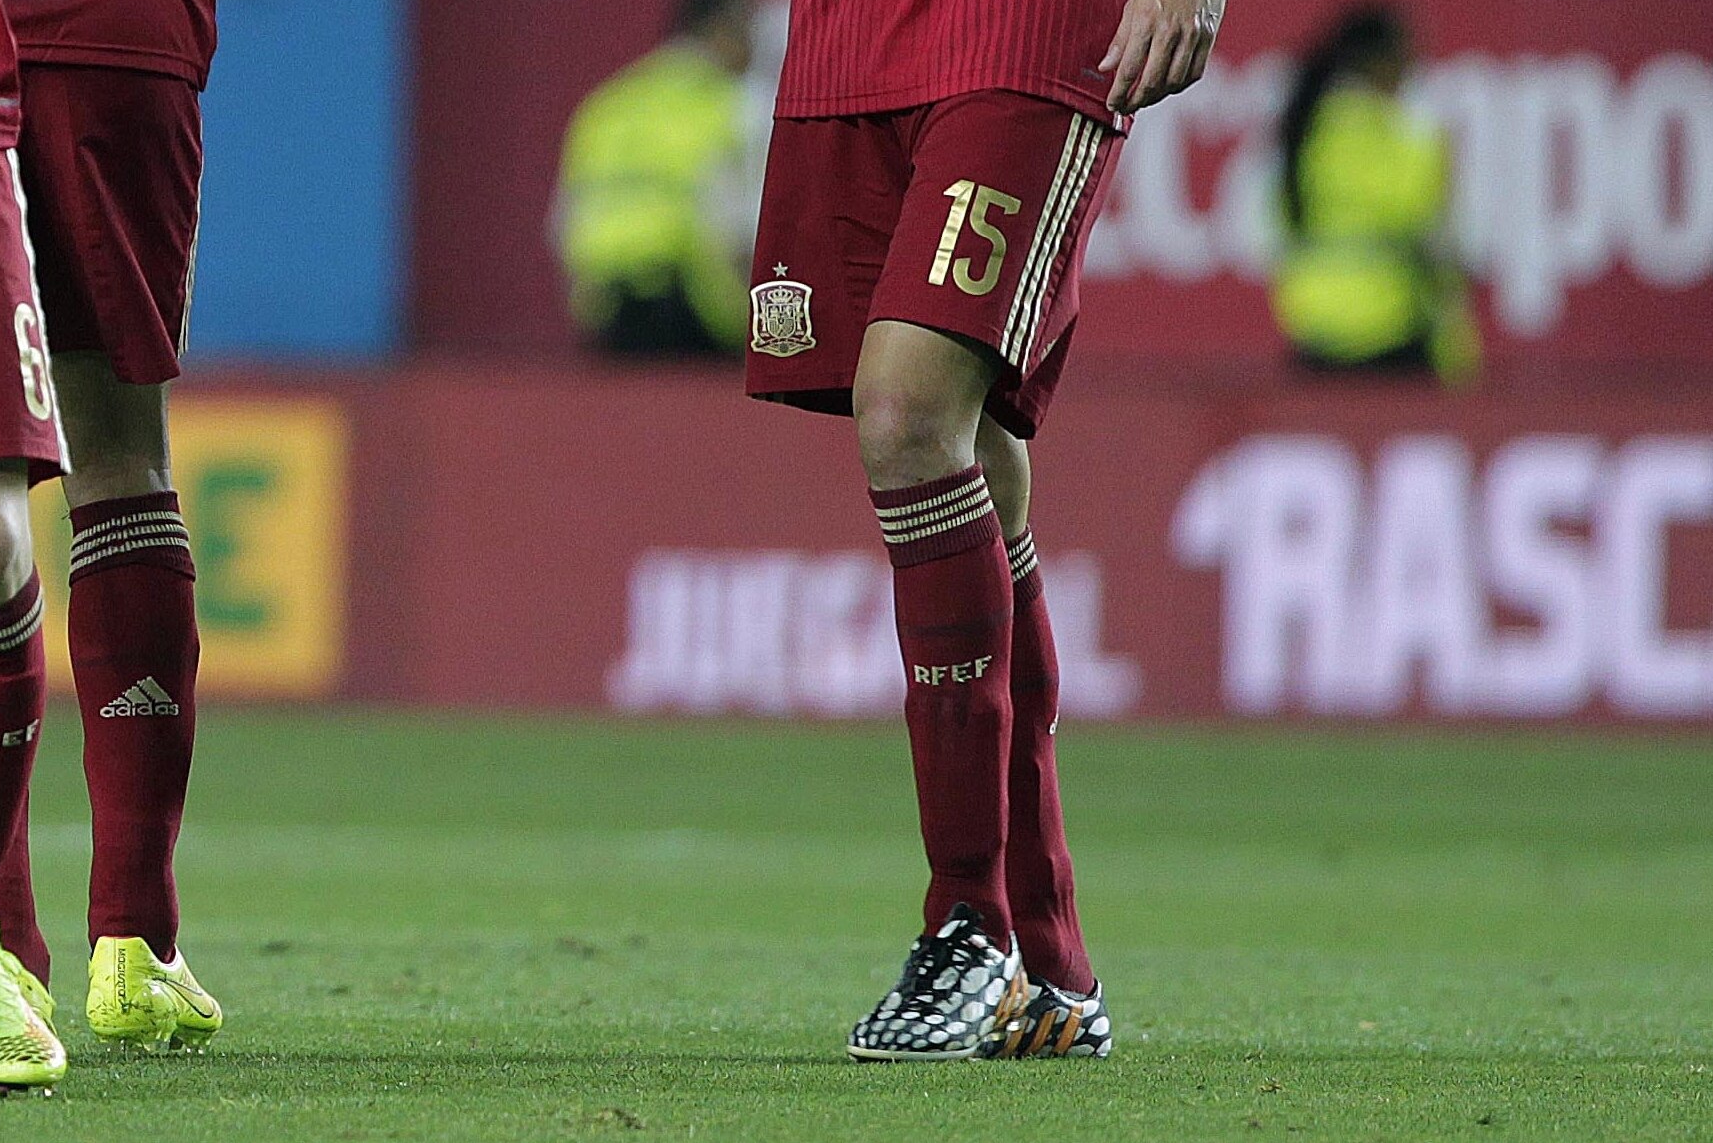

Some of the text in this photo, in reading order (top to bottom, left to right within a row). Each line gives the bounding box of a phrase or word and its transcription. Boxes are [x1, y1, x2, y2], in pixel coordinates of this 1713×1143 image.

[928, 178, 1022, 296] 15
[14, 302, 50, 421] 6
[914, 655, 992, 685] RFEF
[100, 700, 179, 717] adidas
